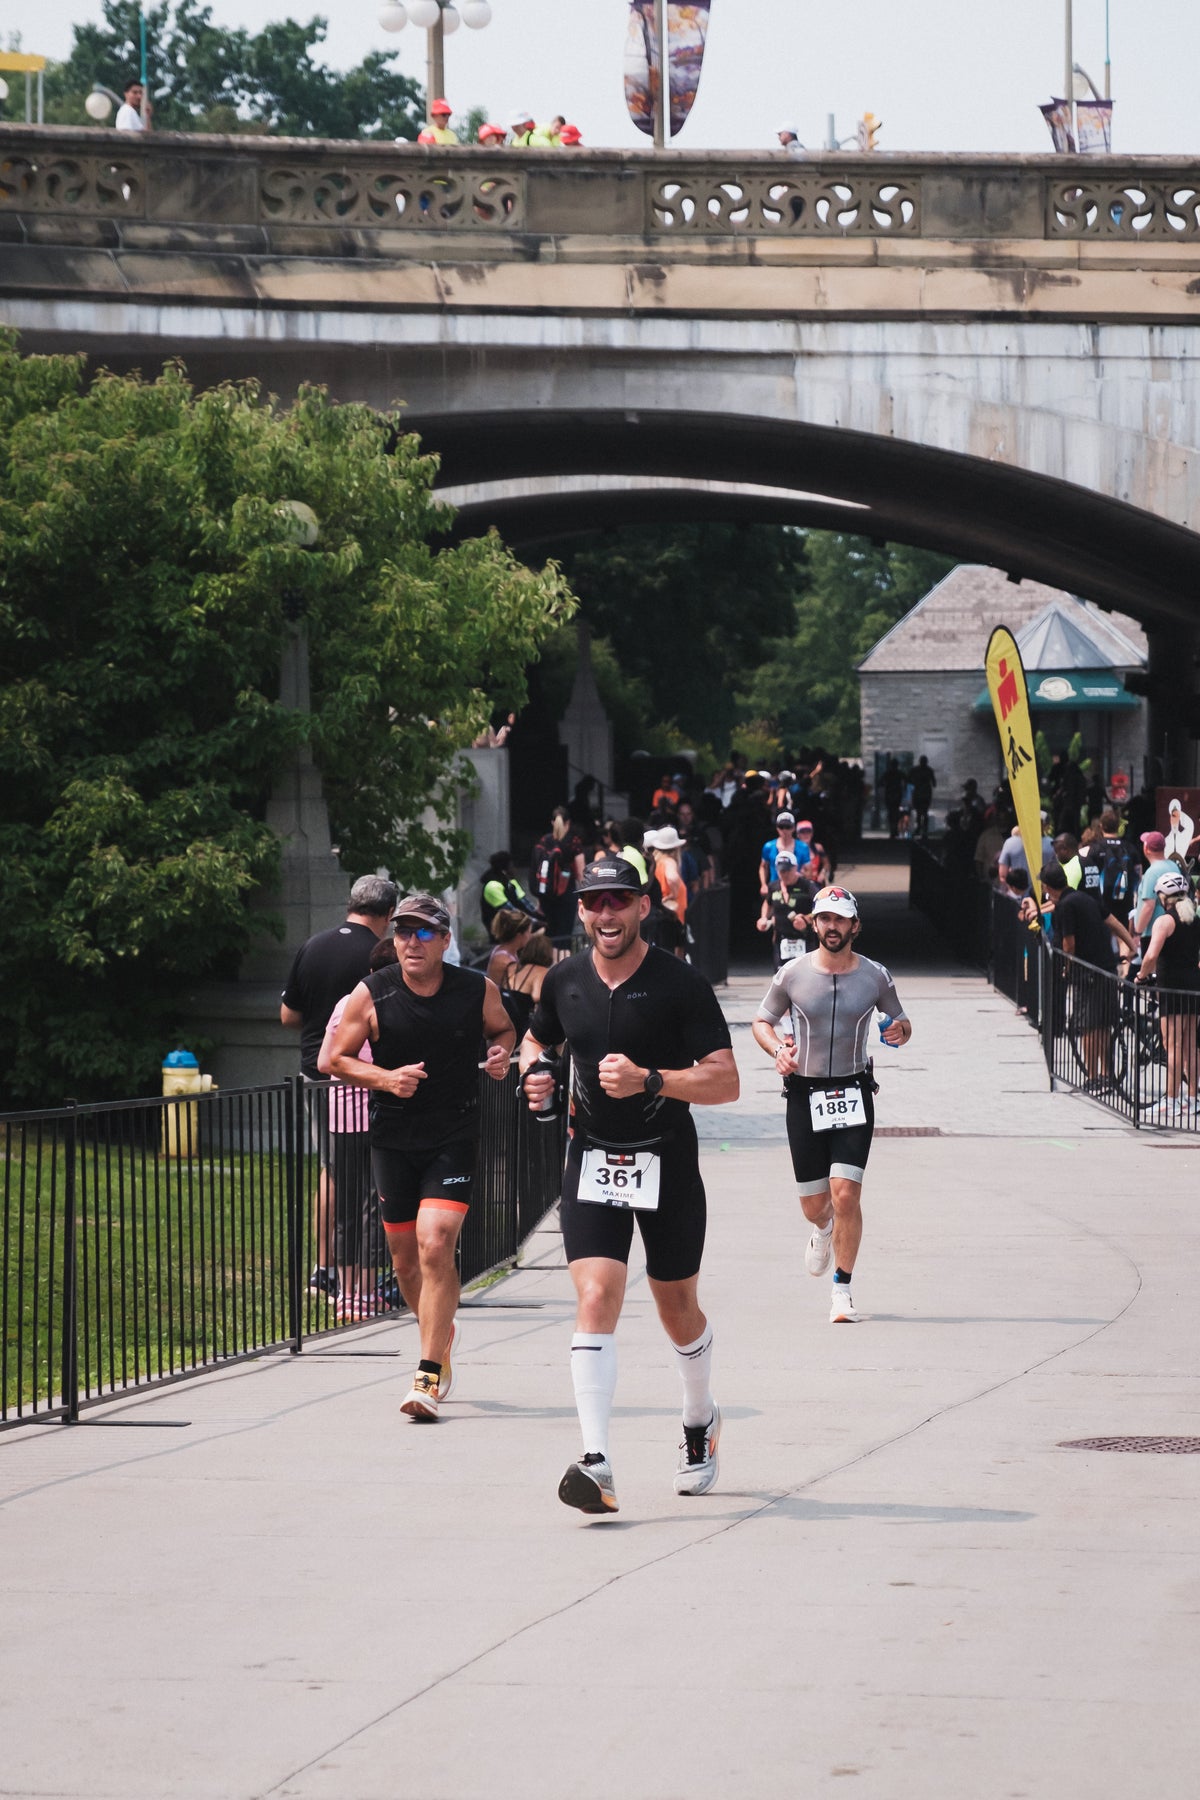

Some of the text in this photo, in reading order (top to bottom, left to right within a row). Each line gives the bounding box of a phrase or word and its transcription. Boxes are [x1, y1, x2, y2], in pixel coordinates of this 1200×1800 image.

[815, 1100, 859, 1117] 1887
[595, 1167, 644, 1189] 361
[602, 1189, 635, 1200] MAXIME
